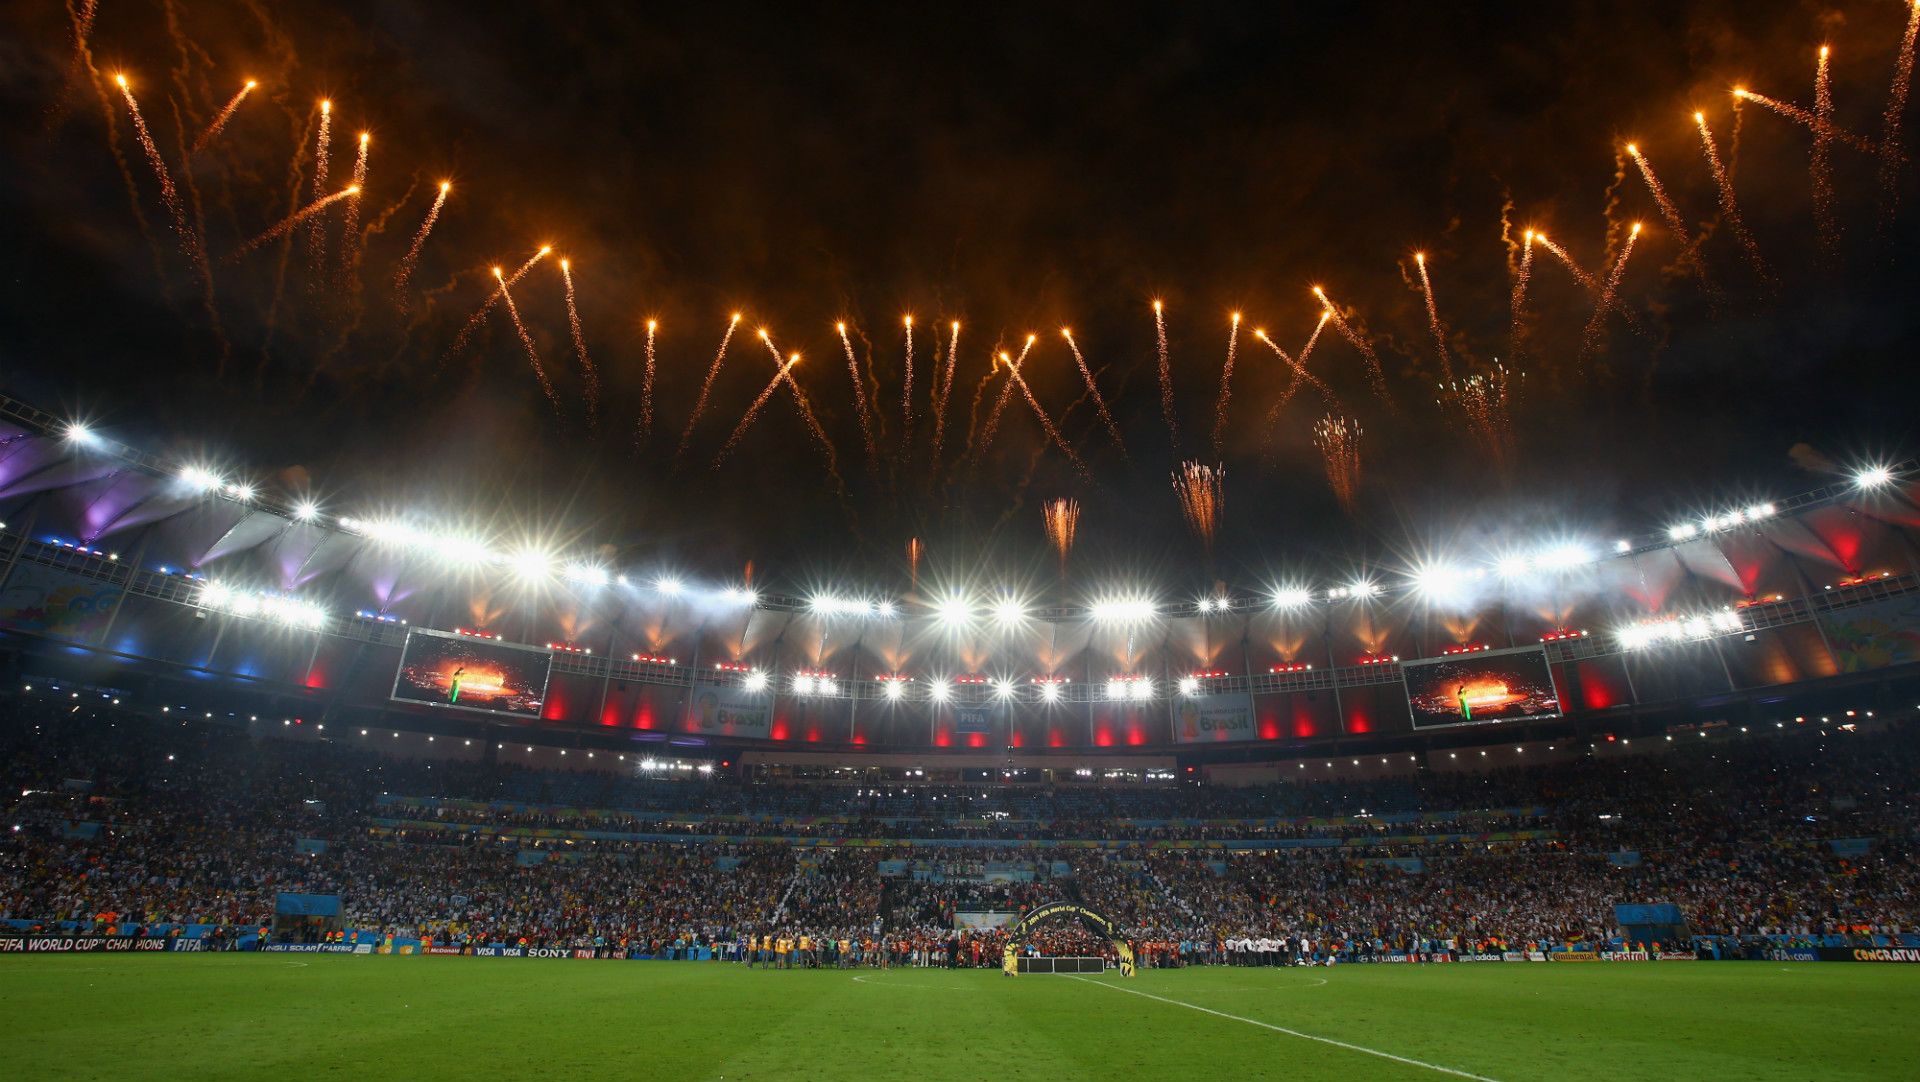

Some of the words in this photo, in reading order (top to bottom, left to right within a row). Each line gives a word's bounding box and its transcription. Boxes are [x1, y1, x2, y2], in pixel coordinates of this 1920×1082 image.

[1080, 907, 1106, 926] Champions
[0, 938, 24, 951] FIFA
[28, 938, 74, 951] WORLD
[106, 938, 165, 950] CHAPIONS
[289, 944, 318, 952] SOLAR
[477, 948, 495, 956] VISA
[503, 949, 521, 957] VISA
[528, 949, 571, 958] SONY
[577, 950, 591, 959] Fly
[1553, 952, 1594, 961] Continental
[1612, 951, 1646, 961] Castrol
